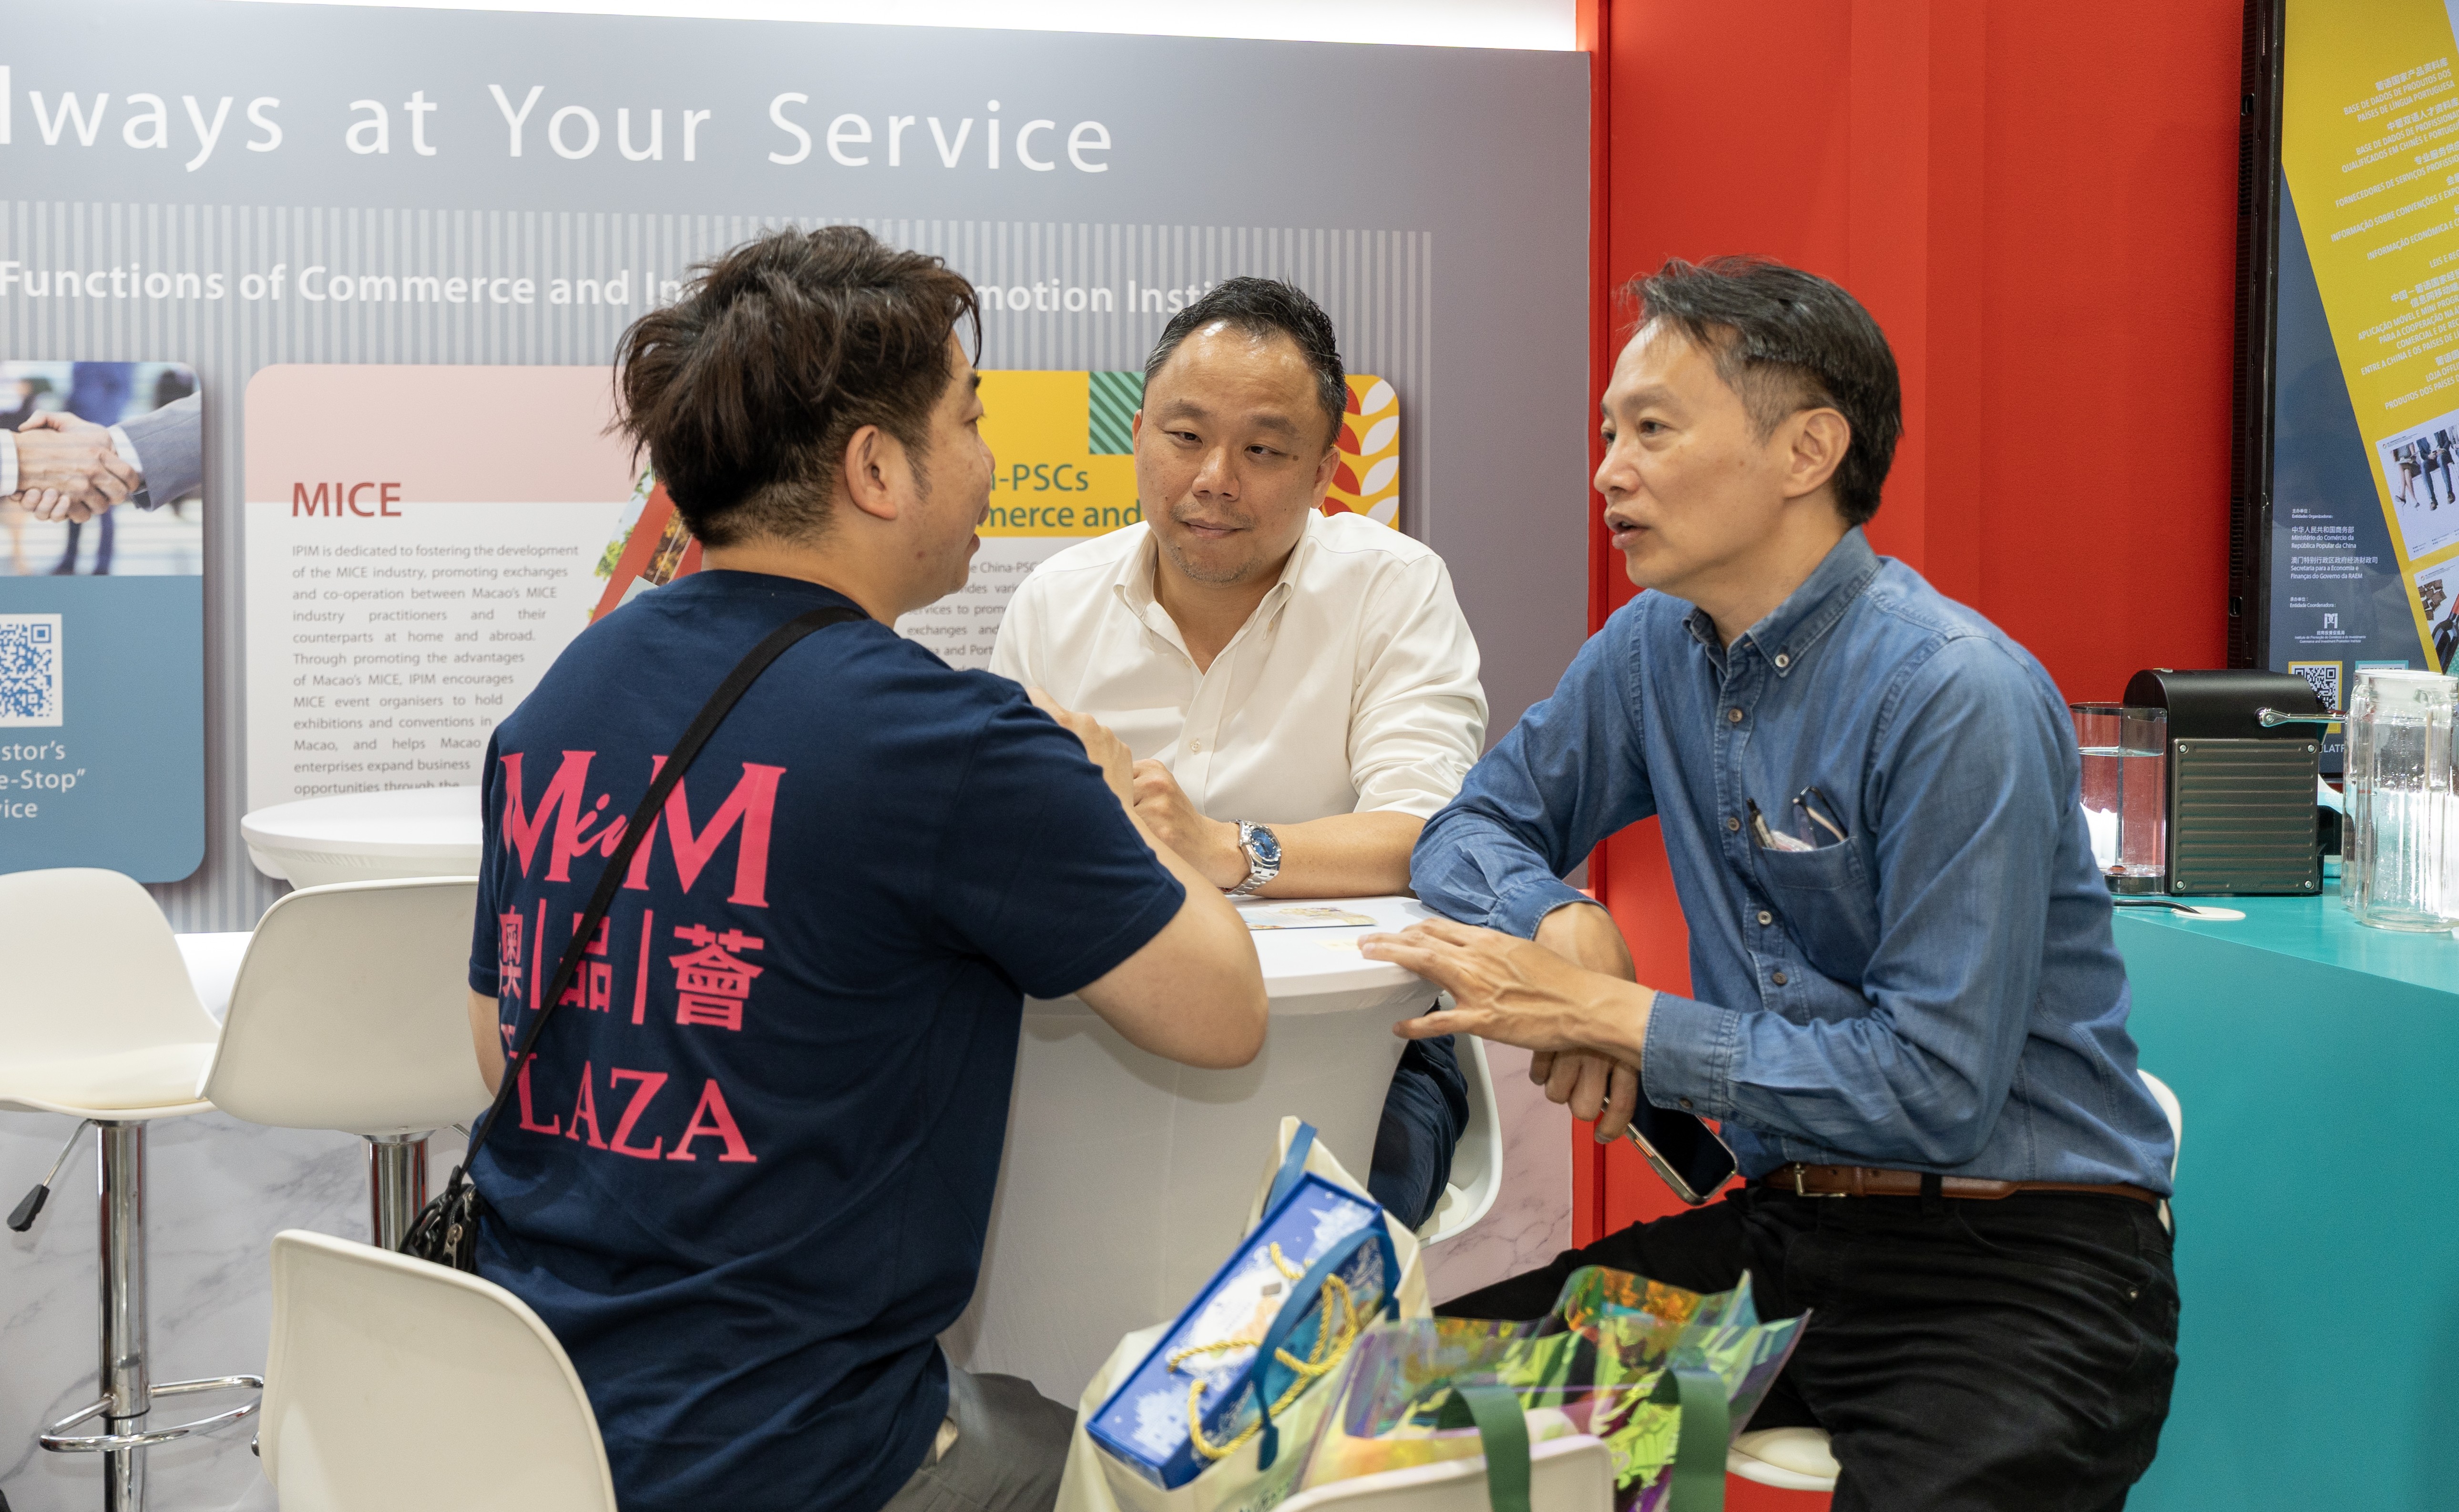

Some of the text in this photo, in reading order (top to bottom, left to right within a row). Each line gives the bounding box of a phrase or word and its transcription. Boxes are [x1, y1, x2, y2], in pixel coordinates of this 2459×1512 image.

[345, 90, 438, 156] at
[488, 84, 711, 162] Your
[768, 92, 1112, 173] Service
[0, 260, 224, 300] Functions
[240, 264, 287, 301] of
[298, 265, 536, 304] Commerce
[549, 269, 629, 305] and
[292, 482, 402, 517] MICE
[1083, 499, 1141, 527] and
[292, 544, 578, 560] IPIM is dedicated to fostering the development
[292, 566, 306, 579] of
[310, 567, 331, 579] the
[336, 566, 367, 578] MICE
[431, 567, 498, 581] promoting
[502, 566, 568, 580] exchanges
[292, 588, 317, 600] and
[323, 589, 404, 603] co-operation
[411, 588, 466, 600] between
[526, 586, 556, 599] MICE
[293, 608, 546, 624] industry practitioners and their
[957, 605, 969, 614] to
[293, 633, 374, 645] counterparts
[384, 632, 397, 643] at
[408, 630, 444, 643] home
[454, 630, 479, 642] and
[907, 625, 967, 638] exchanges
[943, 645, 965, 655] and
[293, 651, 525, 668] Through promoting the advantages
[293, 674, 307, 687] of
[409, 673, 436, 684] IPIM
[442, 674, 514, 687] encourages
[293, 694, 503, 710] MICE event organisers to hold
[293, 715, 492, 730] exhibitions and conventions in
[353, 738, 377, 750] and
[392, 738, 426, 752] helps
[440, 737, 482, 749] Macao
[294, 759, 471, 775] enterprises expand business
[294, 782, 381, 797] opportunities
